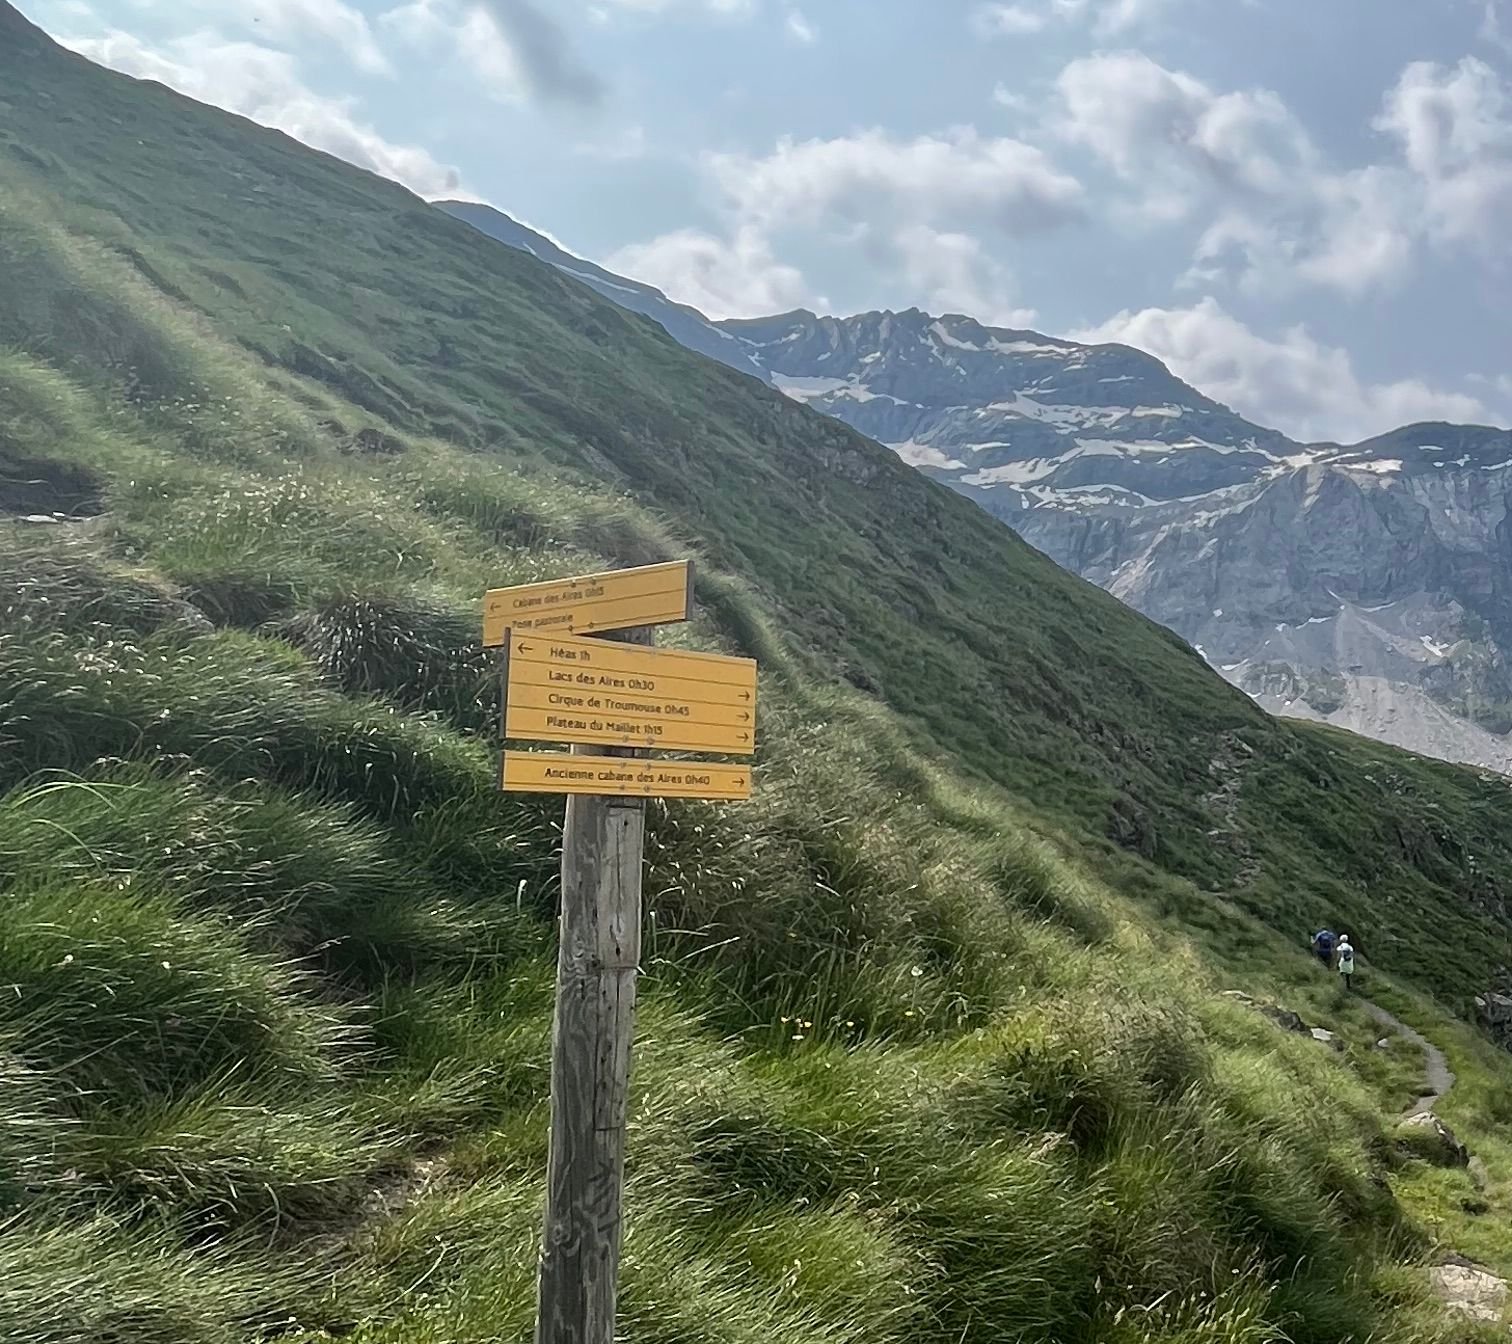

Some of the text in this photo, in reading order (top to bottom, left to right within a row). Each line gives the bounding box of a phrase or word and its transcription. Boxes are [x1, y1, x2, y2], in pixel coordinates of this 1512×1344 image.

[544, 594, 560, 605] des
[562, 590, 582, 602] Aires
[550, 647, 577, 659] Héas
[549, 670, 654, 691] Lacs des Aires 0h30
[548, 694, 690, 716] Cirque de Troumouse 0h45
[546, 716, 663, 735] Plateau du Maillet 1h15
[545, 768, 710, 785] Ancienne cabane des Aires 0h40
